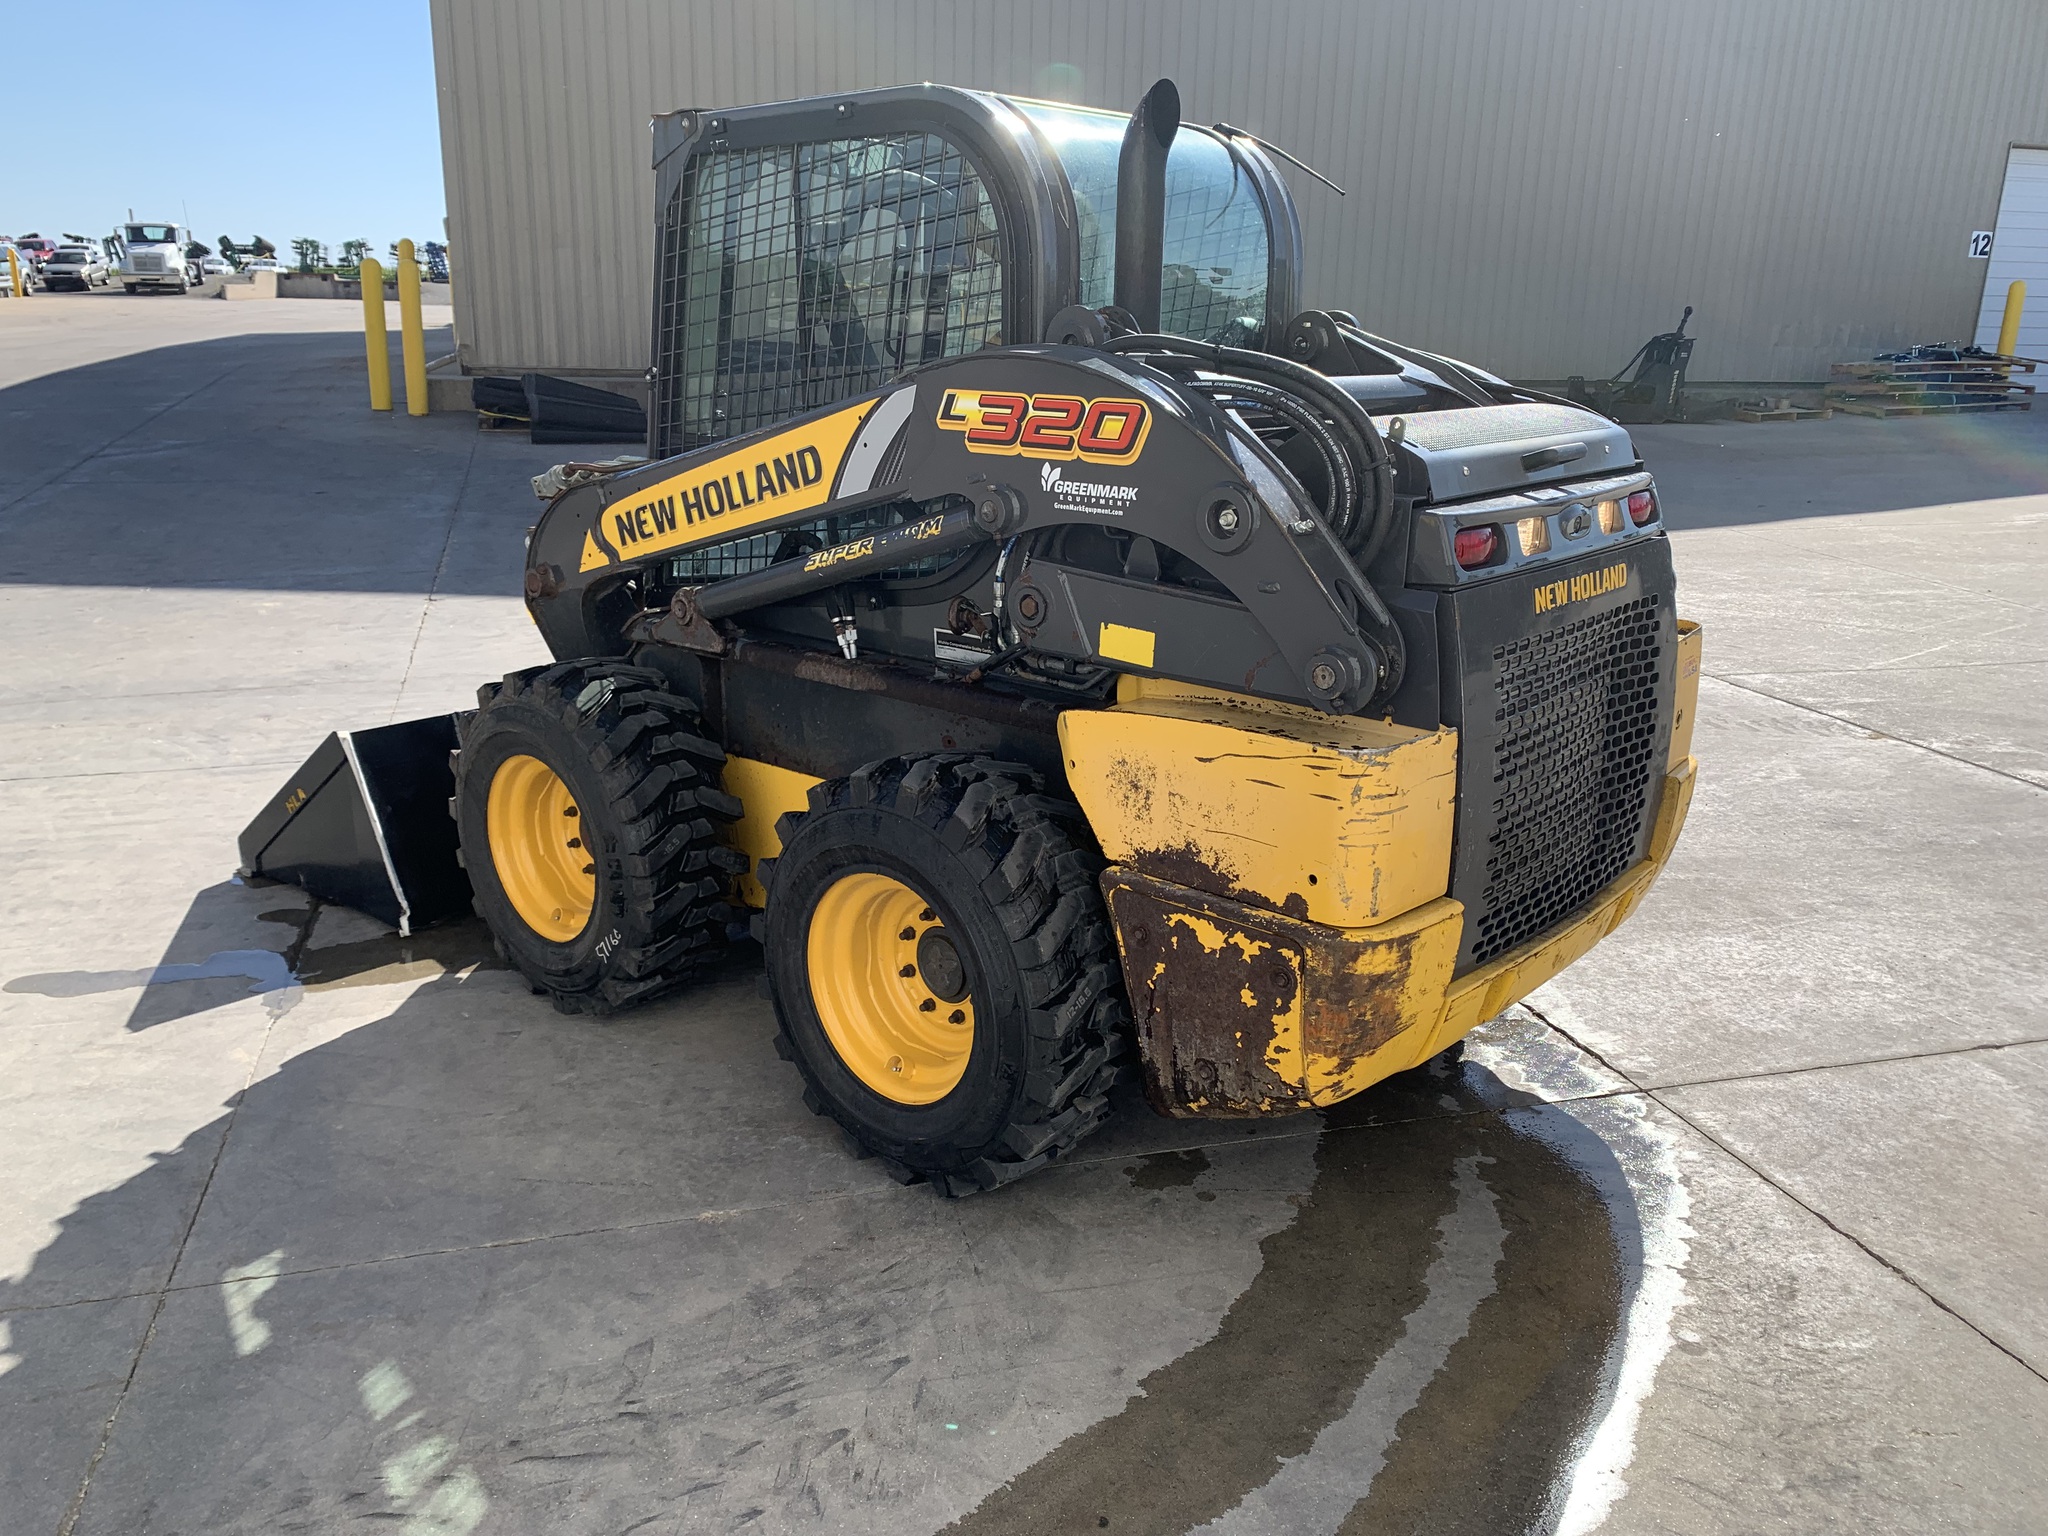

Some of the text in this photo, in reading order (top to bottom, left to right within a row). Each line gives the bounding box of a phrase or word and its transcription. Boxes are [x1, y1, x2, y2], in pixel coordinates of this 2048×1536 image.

[1971, 233, 1991, 256] 12
[938, 391, 1150, 460] L320
[615, 444, 823, 548] NEW HOLLAND
[1053, 480, 1139, 501] GREENMARK
[1059, 494, 1131, 508] EQUIPMENT
[1053, 502, 1124, 516] GreenMarkEquipment.com
[1534, 562, 1628, 614] NEW HOLLAND
